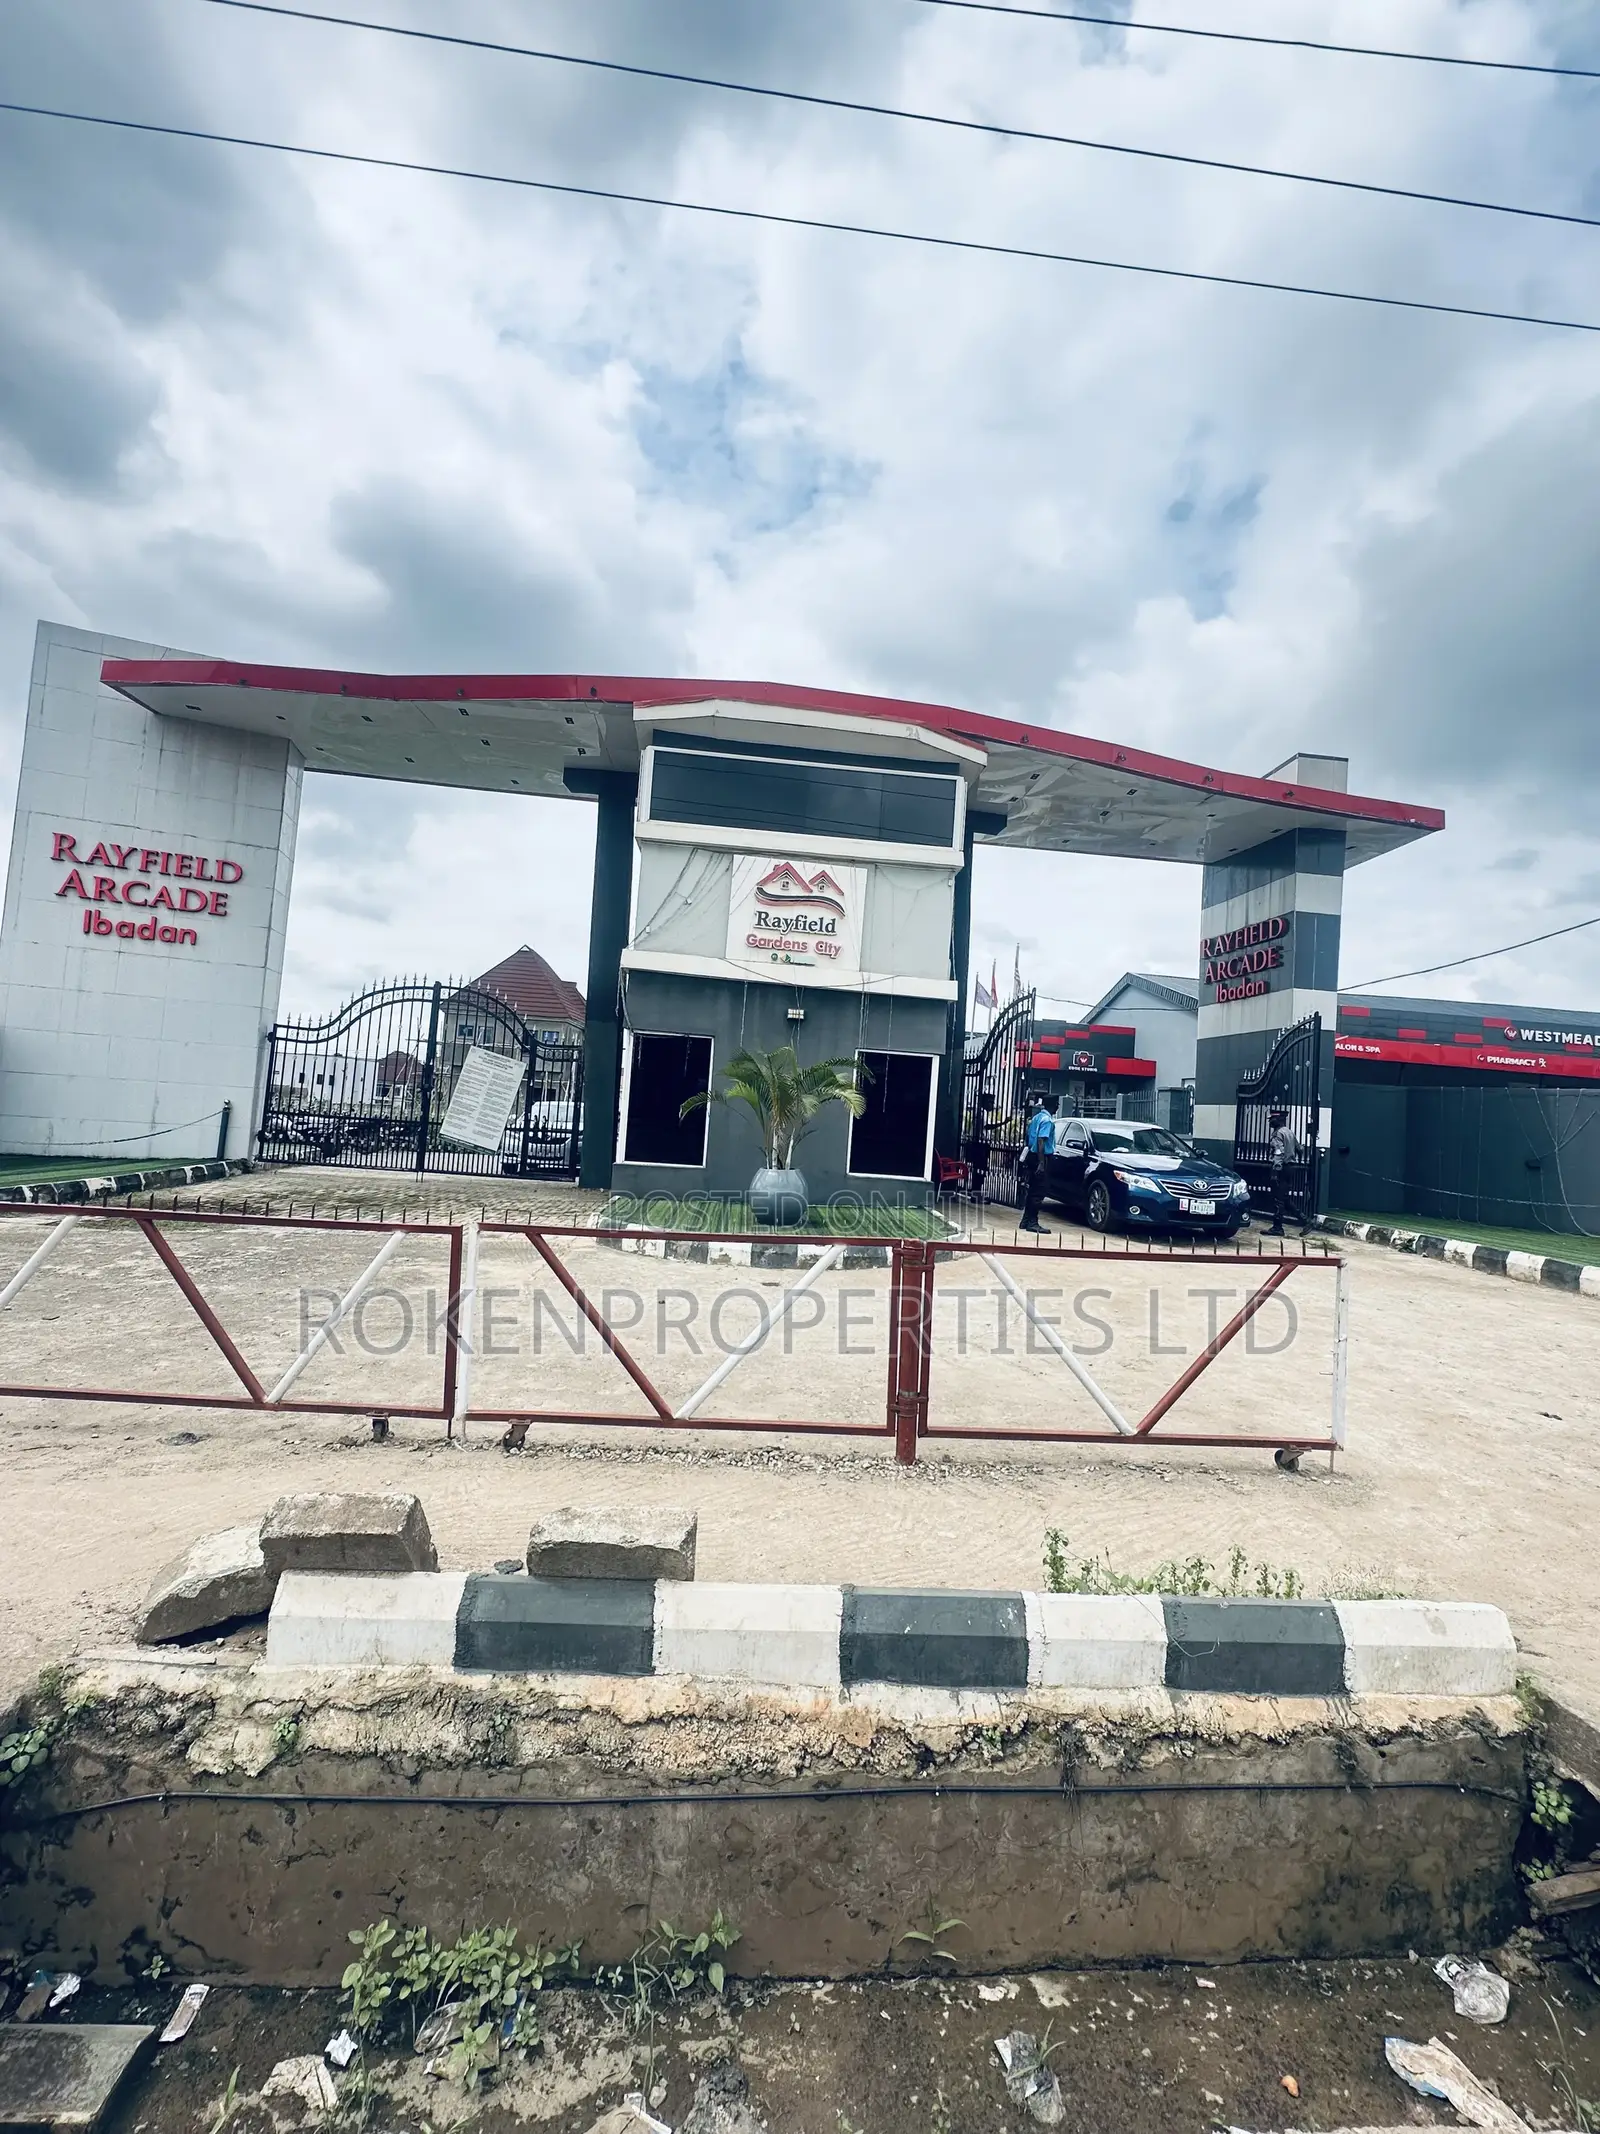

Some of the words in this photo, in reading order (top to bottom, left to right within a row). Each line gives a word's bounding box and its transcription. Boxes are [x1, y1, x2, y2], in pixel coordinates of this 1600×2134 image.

[51, 832, 243, 883] RAYFIELD
[54, 868, 228, 916] ARCADE
[83, 909, 198, 945] Ibadan
[755, 911, 836, 933] Rayfield
[746, 934, 808, 951] Gardens
[1201, 917, 1284, 960] RAYFIELD
[1204, 946, 1280, 984] ARCADE
[1215, 977, 1265, 1003] Ibadan
[1335, 1043, 1357, 1051] ALON
[1487, 1056, 1536, 1066] PHARMACY
